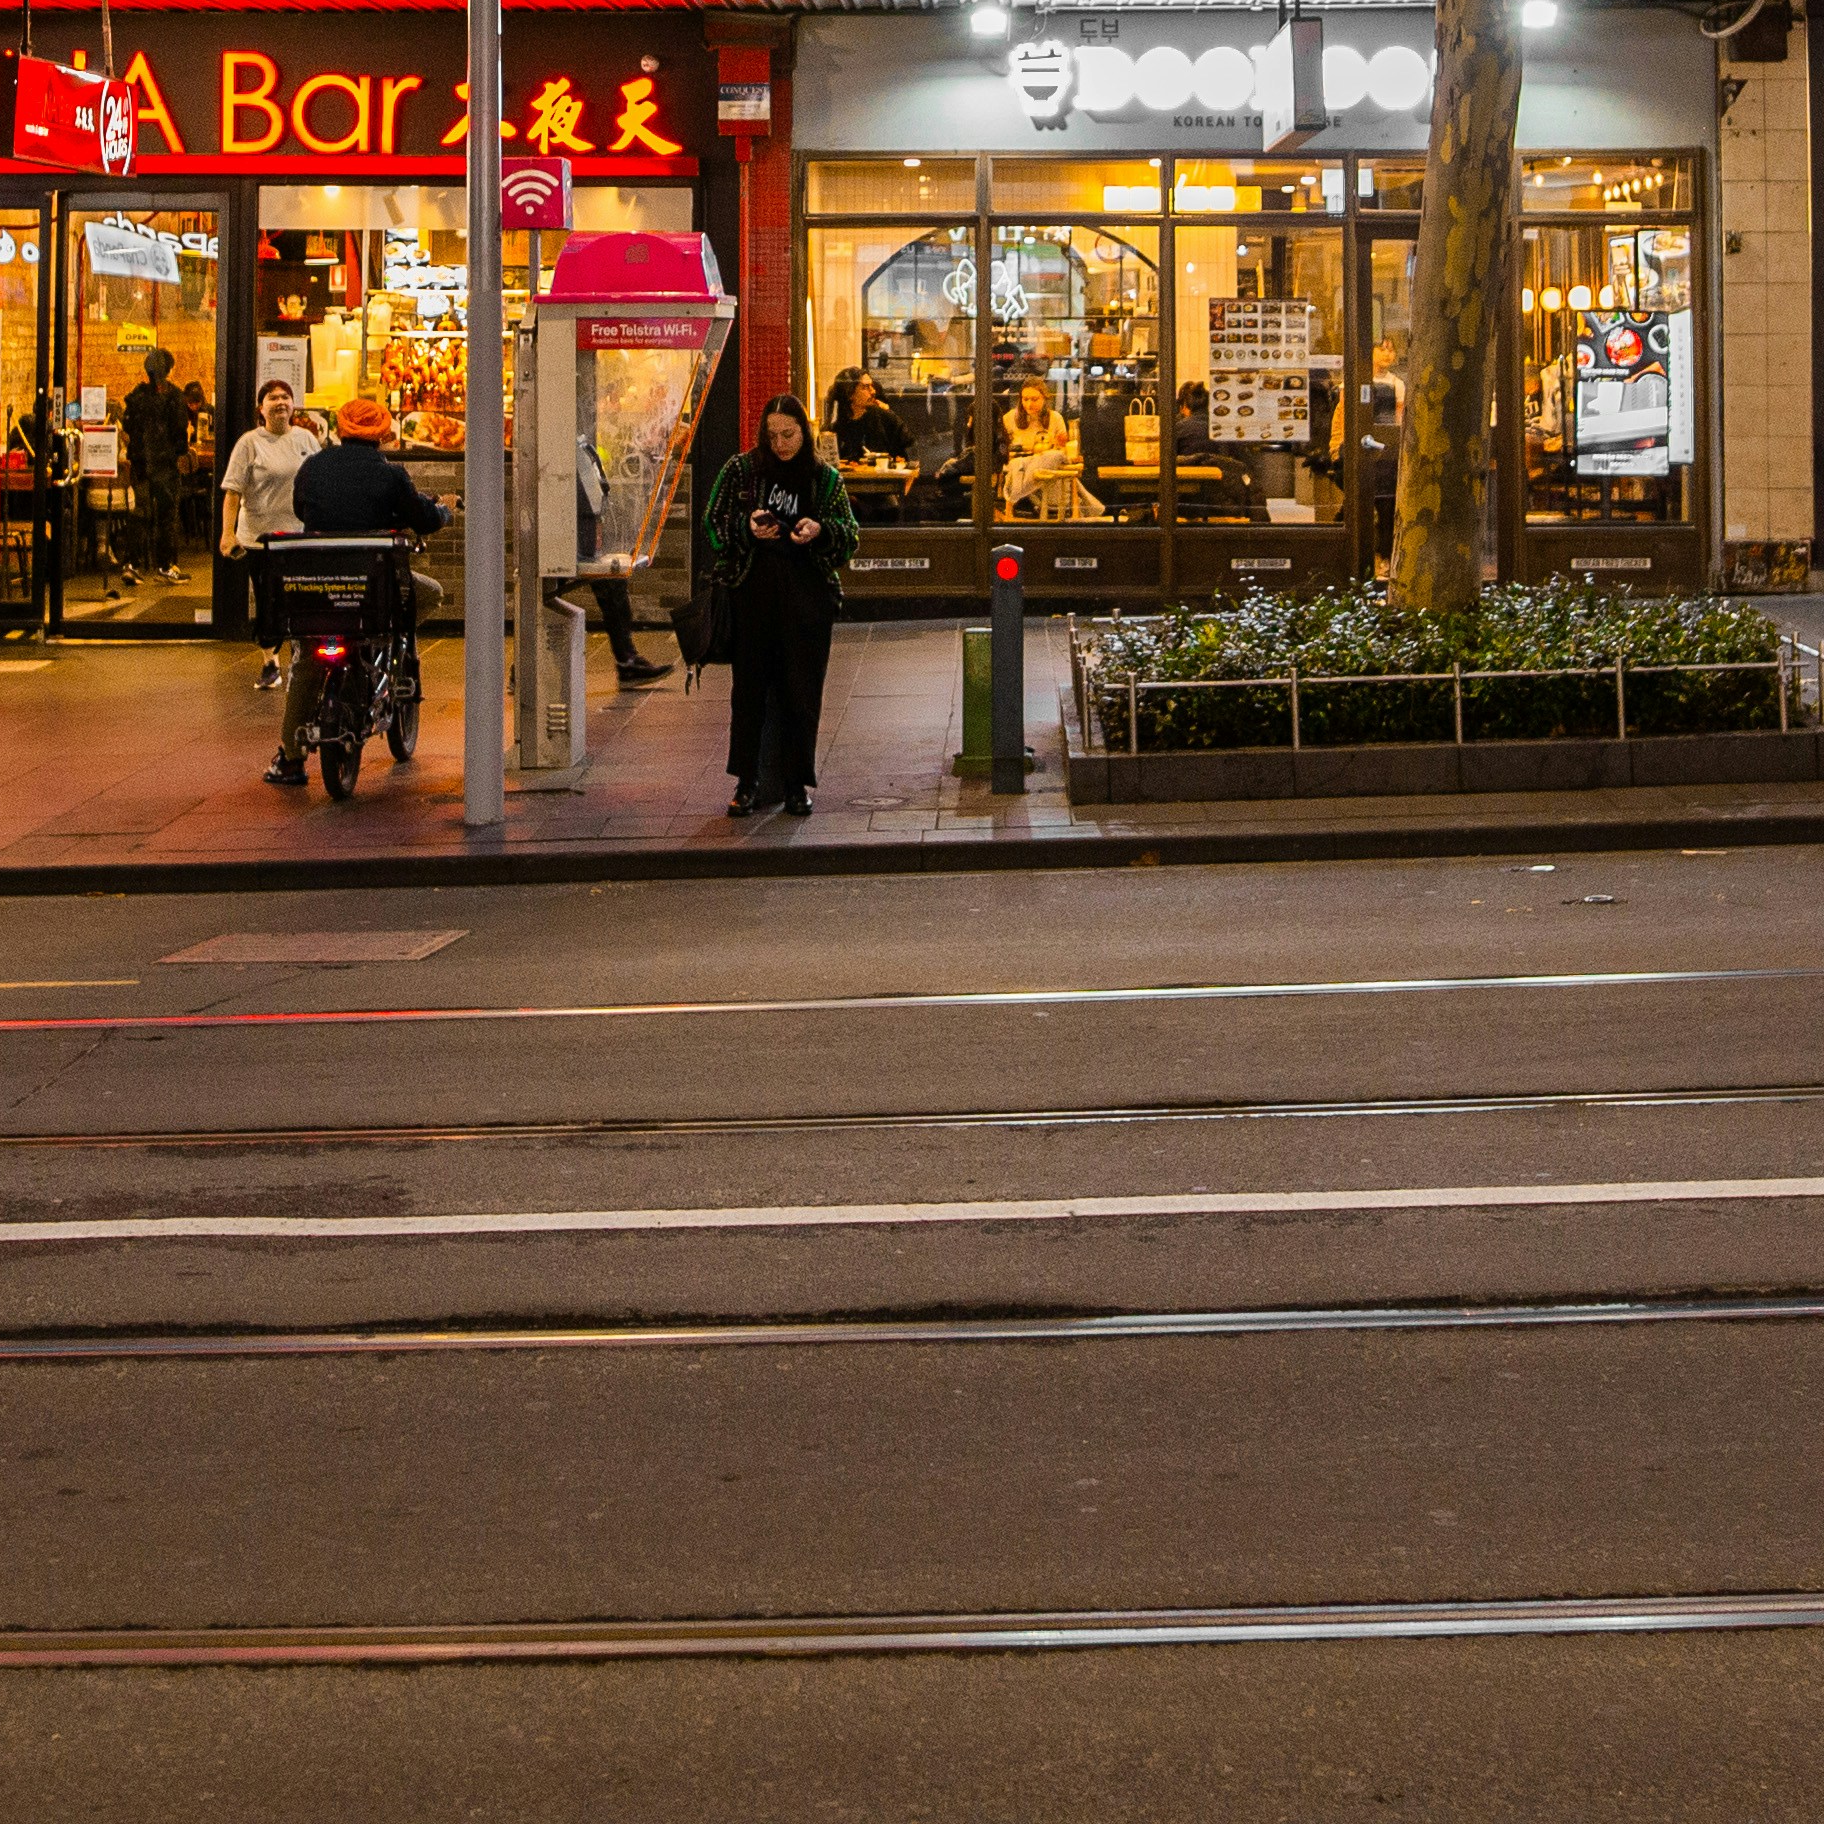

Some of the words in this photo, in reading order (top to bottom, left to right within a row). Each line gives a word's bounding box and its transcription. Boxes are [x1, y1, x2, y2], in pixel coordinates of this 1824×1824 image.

[1080, 18, 1120, 44] 두부
[221, 50, 423, 155] Bar
[1174, 116, 1235, 127] KOREAN
[591, 324, 618, 336] Free
[619, 324, 662, 336] Telstra
[663, 324, 697, 337] Wi-Fi.
